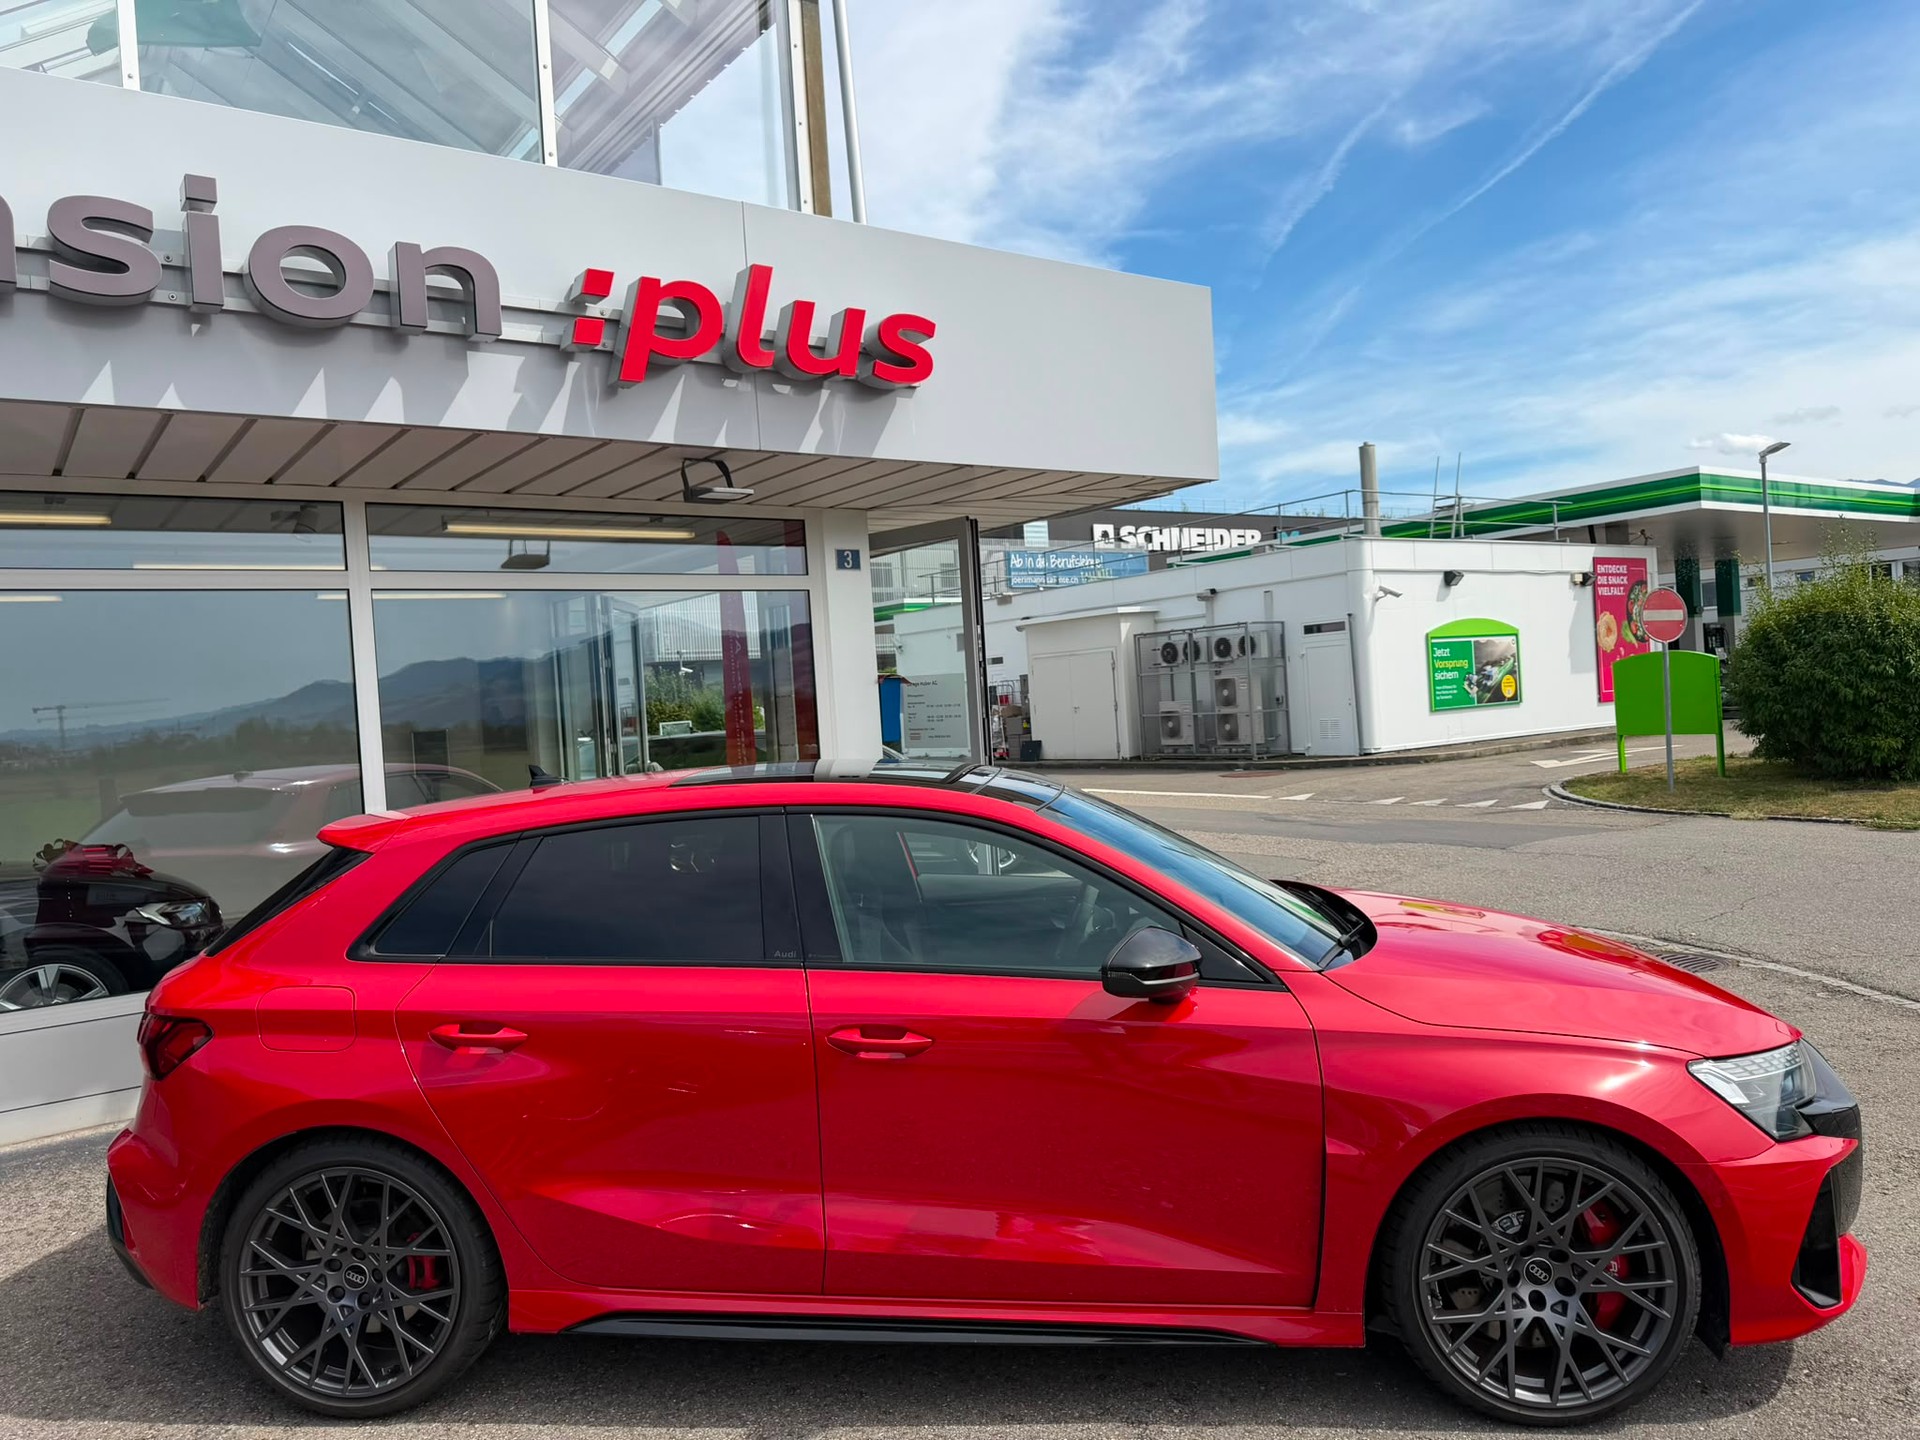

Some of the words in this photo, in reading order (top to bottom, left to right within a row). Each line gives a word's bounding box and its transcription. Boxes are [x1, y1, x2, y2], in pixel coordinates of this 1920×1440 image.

[0, 173, 502, 344] sion
[1119, 525, 1262, 552] SCHNEIDER
[844, 550, 853, 568] 3
[1010, 554, 1024, 568] Ab
[1025, 554, 1035, 568] in
[1597, 564, 1628, 574] ENTDECKE
[1597, 576, 1607, 585] DIE
[1608, 576, 1628, 585] SNACK
[1433, 647, 1451, 657] Jetzt
[1434, 659, 1468, 669] Vorsprung
[1435, 670, 1459, 680] sichern
[774, 950, 797, 959] Audi
